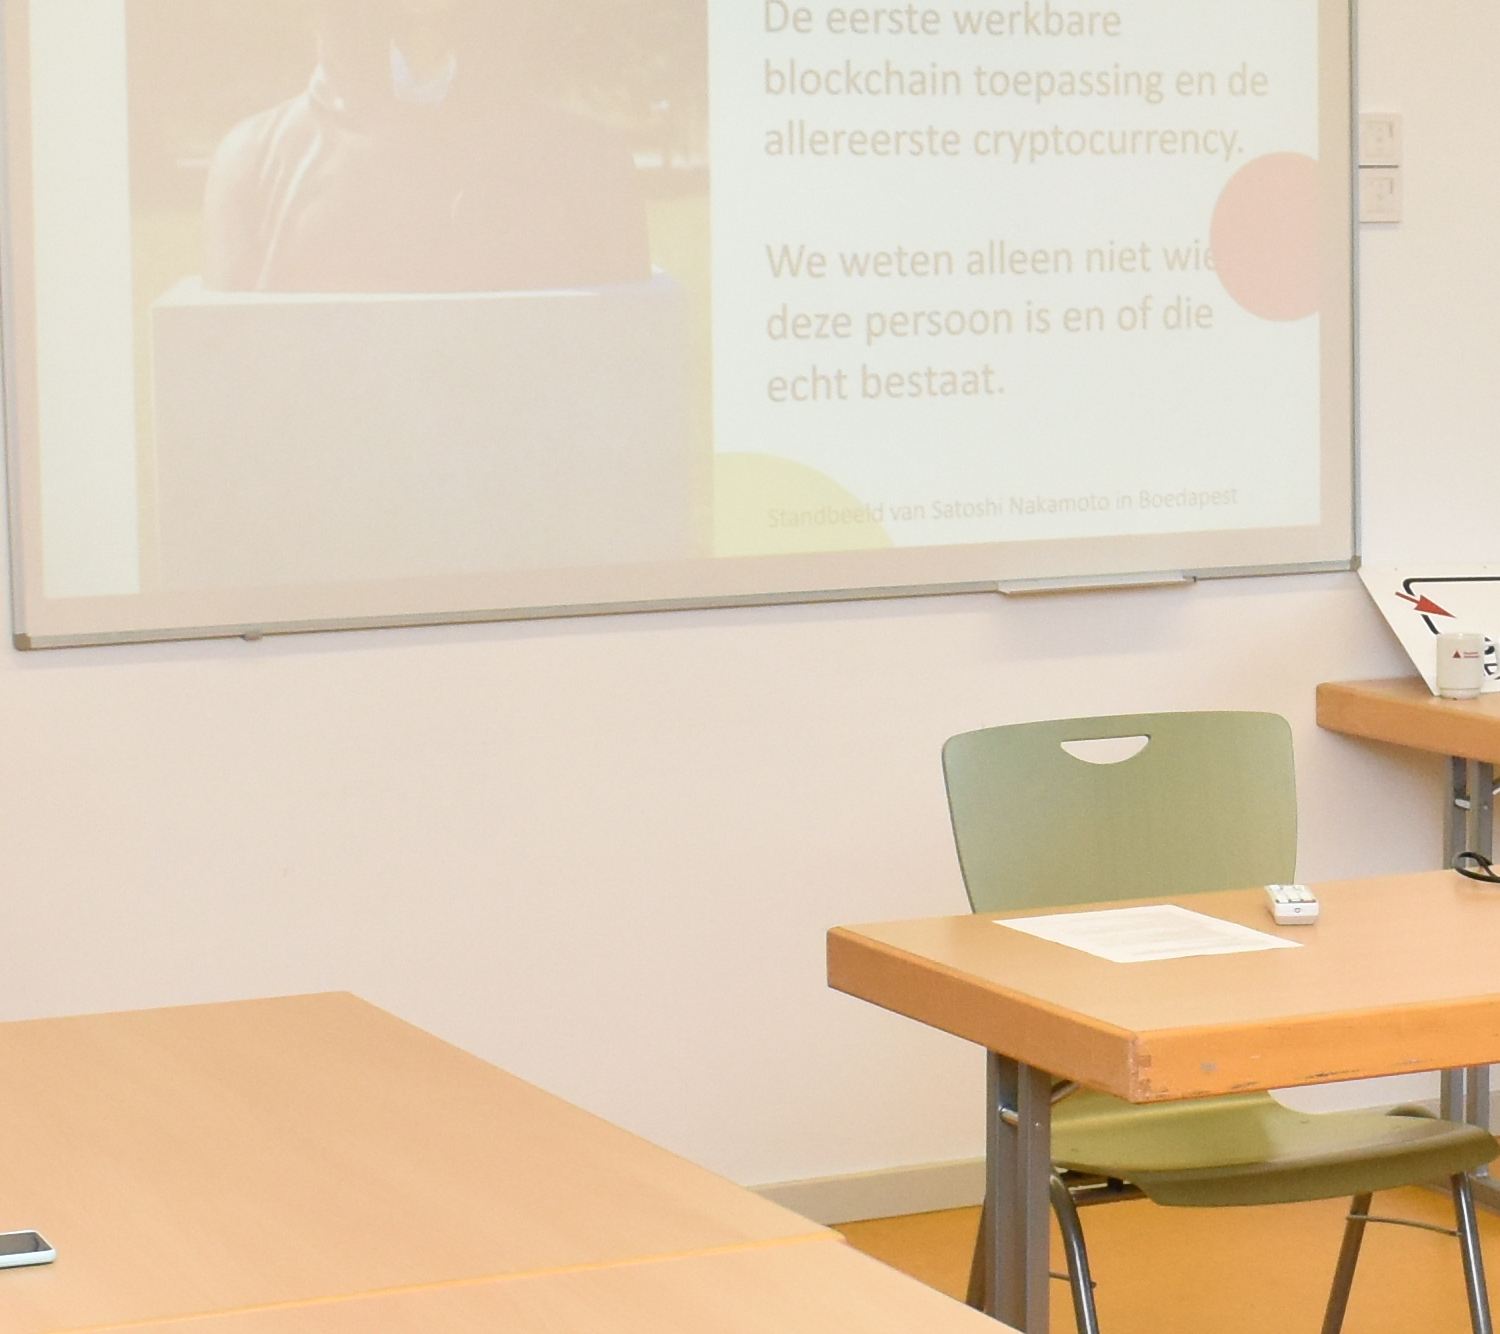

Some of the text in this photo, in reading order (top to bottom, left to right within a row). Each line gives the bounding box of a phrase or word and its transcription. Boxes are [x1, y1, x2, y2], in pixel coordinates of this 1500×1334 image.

[826, 3, 941, 35] eerste
[954, 0, 1121, 37] werkbare
[765, 58, 1268, 105] blockchain toepassing en de
[765, 119, 1243, 163] allereerste cryptocurrency.
[766, 244, 827, 279] We
[839, 246, 953, 278] weten
[967, 240, 1073, 275] alleen
[1086, 240, 1152, 273] niet
[766, 295, 1214, 346] deze persoon is en of die
[767, 364, 1005, 402] echt bestaat.
[768, 488, 1238, 529] Standbeeld van Satoshi Nakamoto in Boedapest
